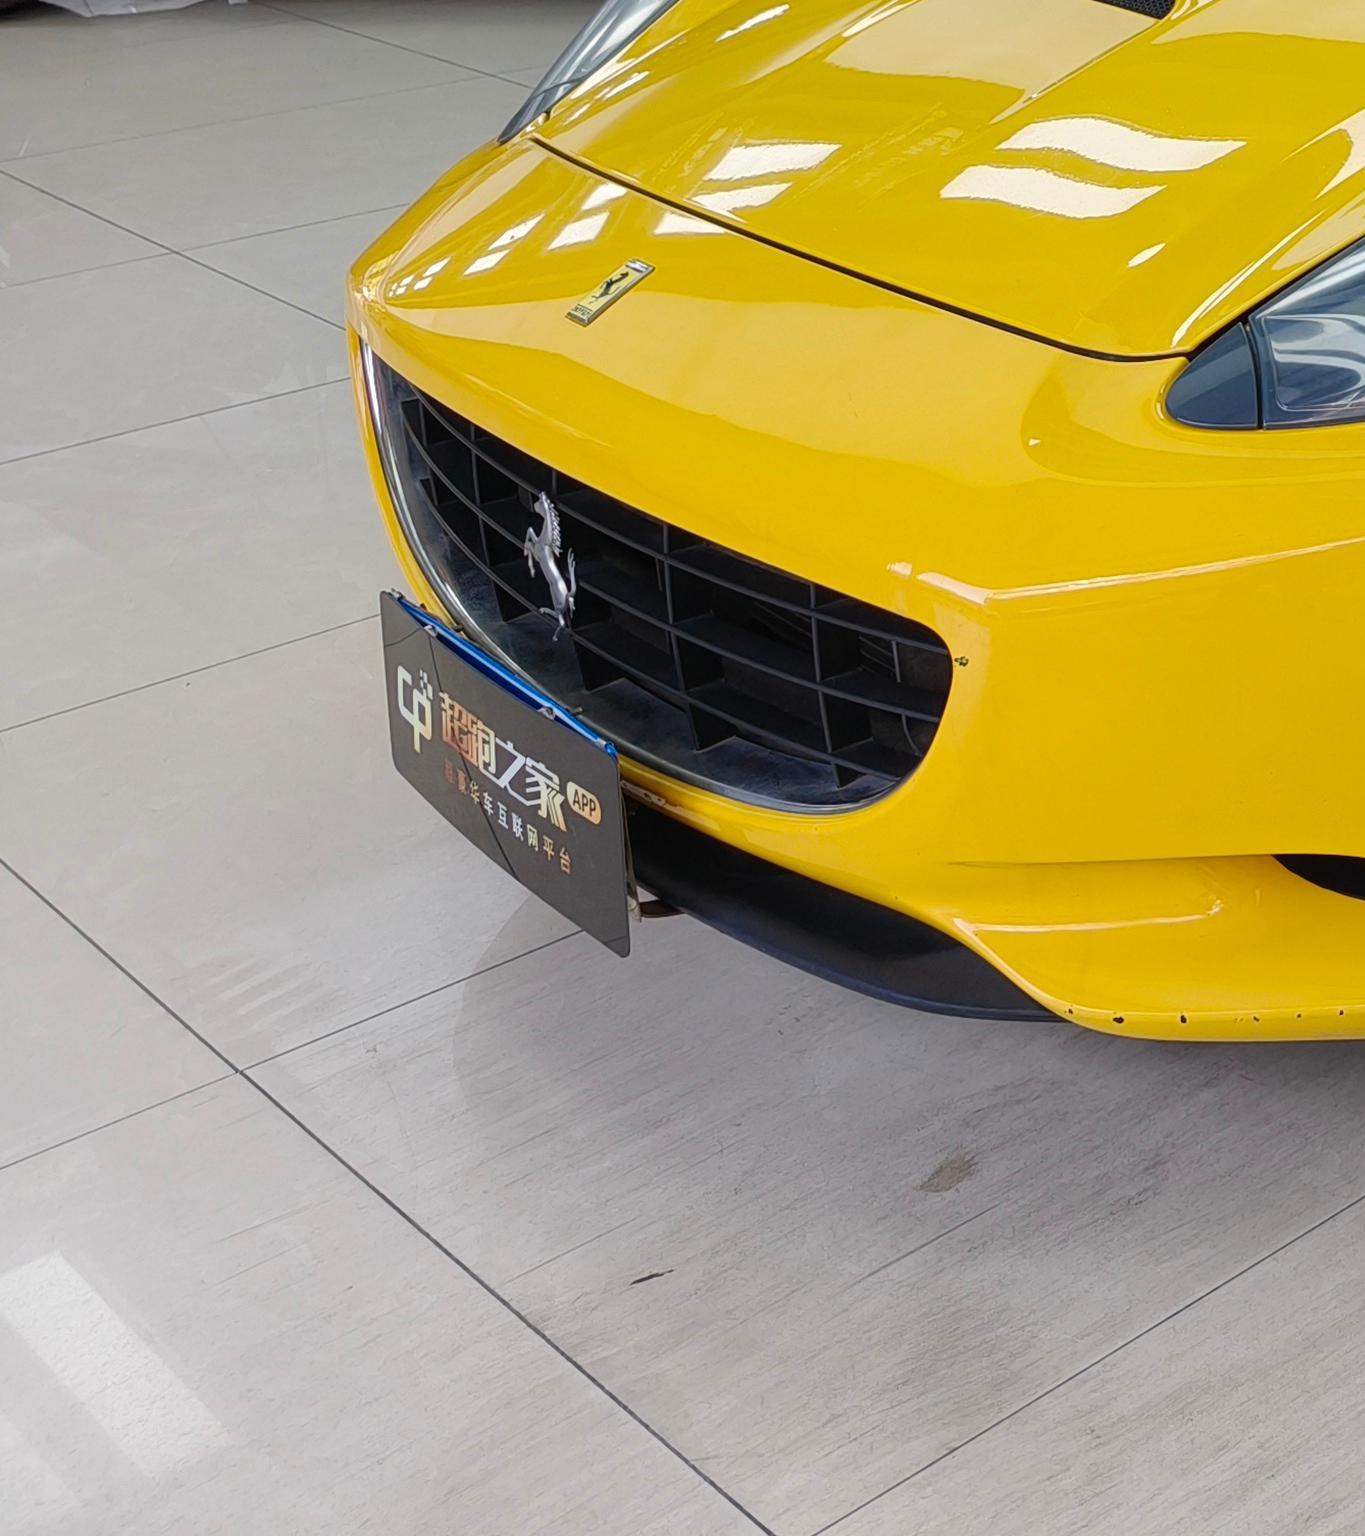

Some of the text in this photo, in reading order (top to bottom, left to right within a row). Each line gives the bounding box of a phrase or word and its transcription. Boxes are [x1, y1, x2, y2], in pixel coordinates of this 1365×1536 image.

[437, 691, 568, 833] 超跑之家
[572, 788, 599, 818] APP
